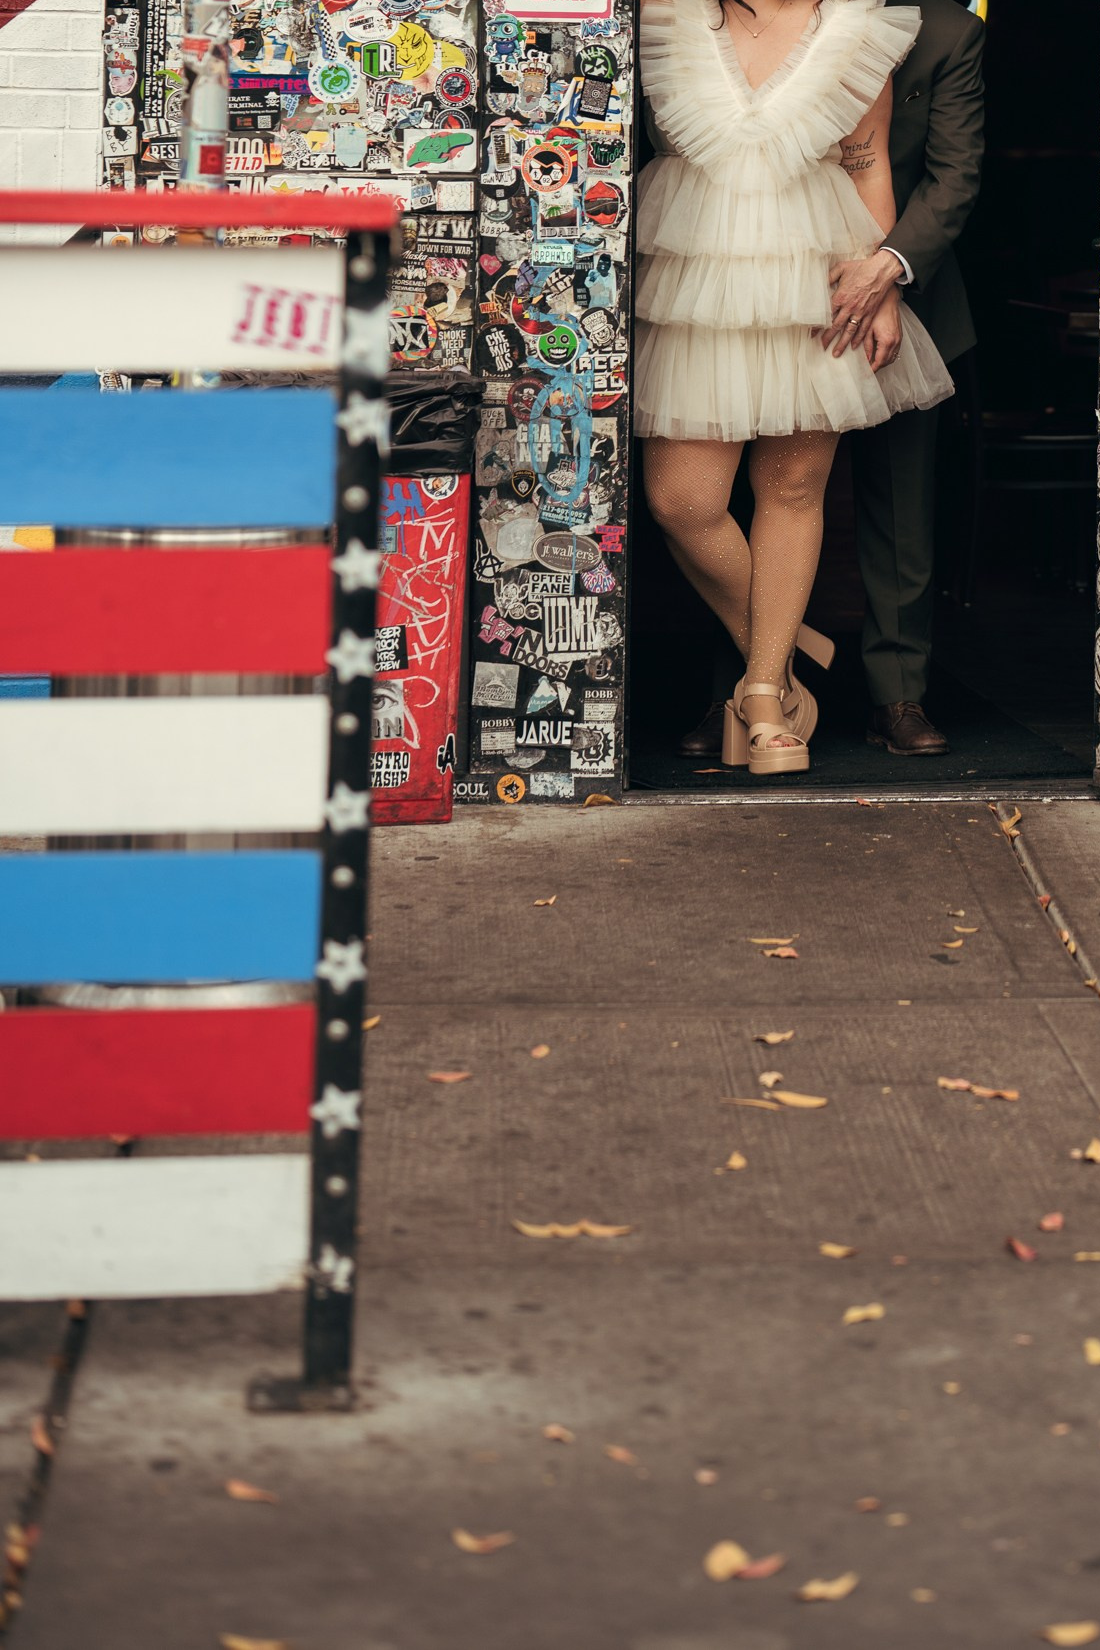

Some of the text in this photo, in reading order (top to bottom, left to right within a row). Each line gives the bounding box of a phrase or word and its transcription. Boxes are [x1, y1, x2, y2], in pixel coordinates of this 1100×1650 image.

[349, 16, 375, 28] COMMUNITY
[363, 23, 375, 31] NEWS
[145, 43, 153, 76] Drunker
[417, 244, 471, 255] DOWN FOR WAR
[391, 280, 427, 288] HORSEMEN
[438, 330, 467, 341] SMOKE
[486, 329, 508, 346] CHE
[441, 339, 464, 349] WEED
[445, 348, 460, 358] PET
[489, 342, 510, 358] MIC
[495, 353, 513, 372] ALS
[597, 526, 623, 534] READY
[532, 574, 571, 583] OFTEN
[532, 583, 570, 595] FANE
[543, 596, 599, 652] UDMK
[377, 651, 395, 661] KRS
[513, 651, 568, 680] DOORS
[481, 718, 516, 729] BOBBY
[516, 720, 573, 745] JARUE
